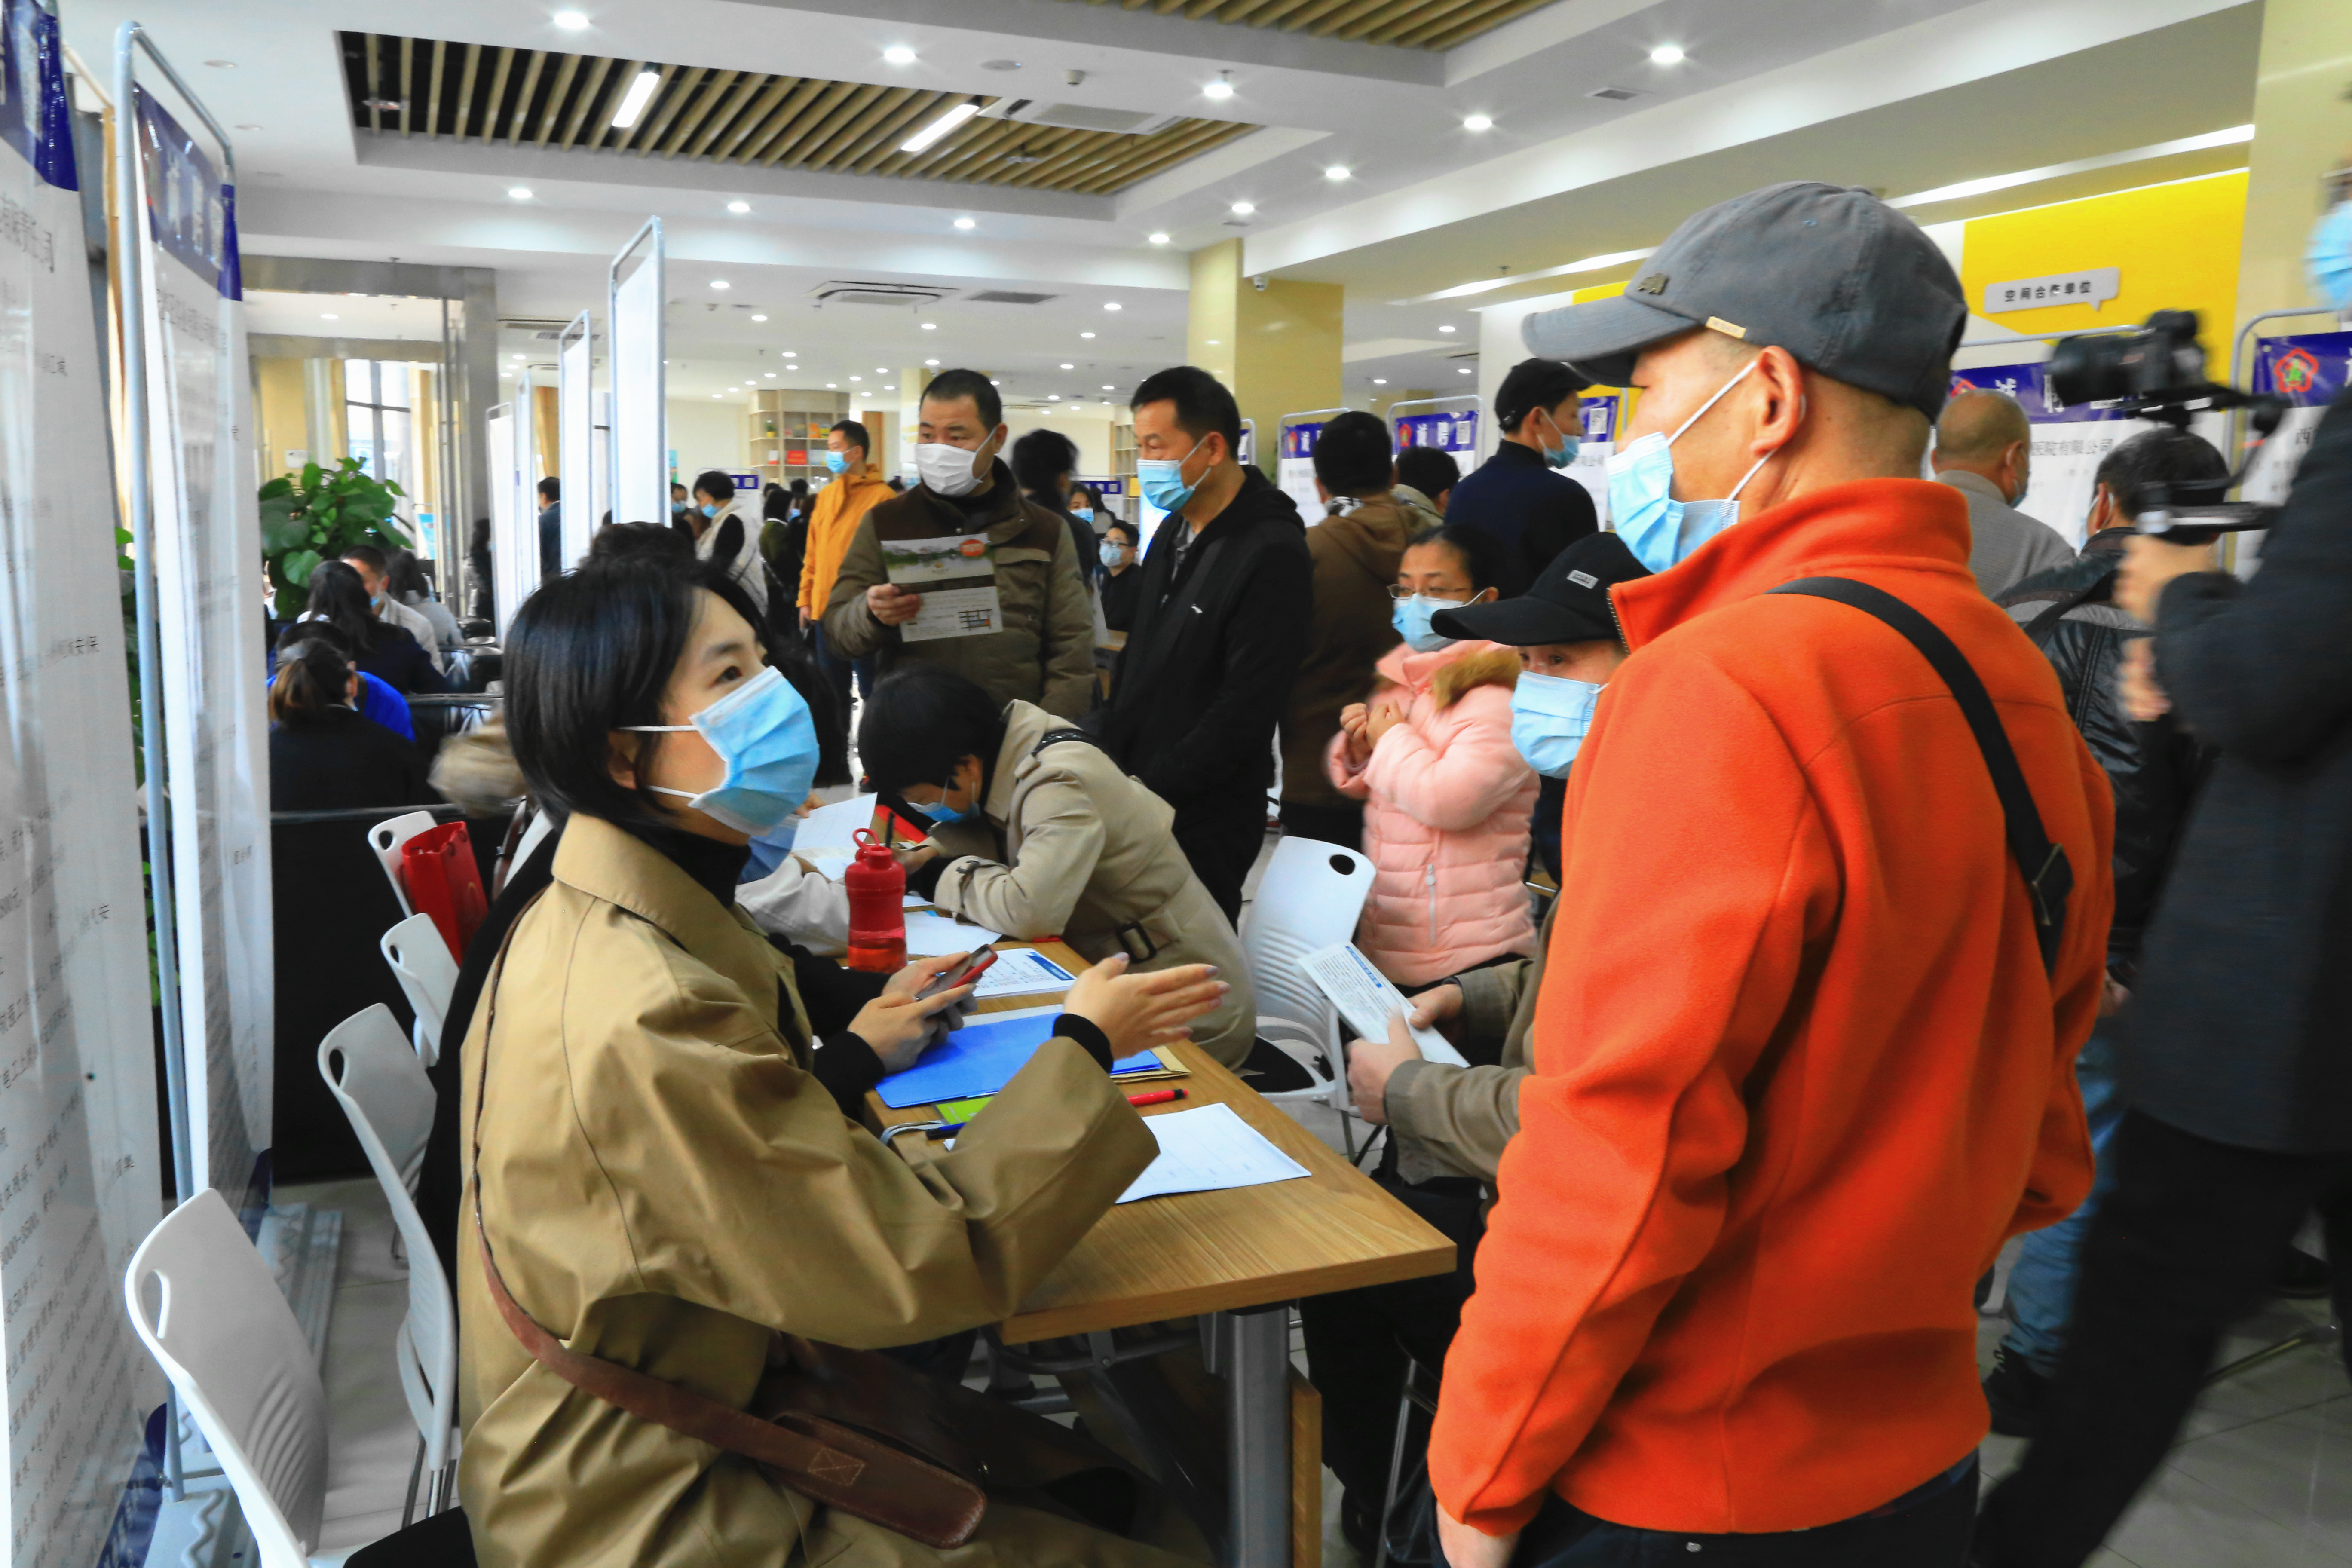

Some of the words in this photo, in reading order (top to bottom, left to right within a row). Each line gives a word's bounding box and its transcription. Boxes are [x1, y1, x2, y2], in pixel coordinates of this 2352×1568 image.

[2005, 280, 2091, 302] 空间合作单位
